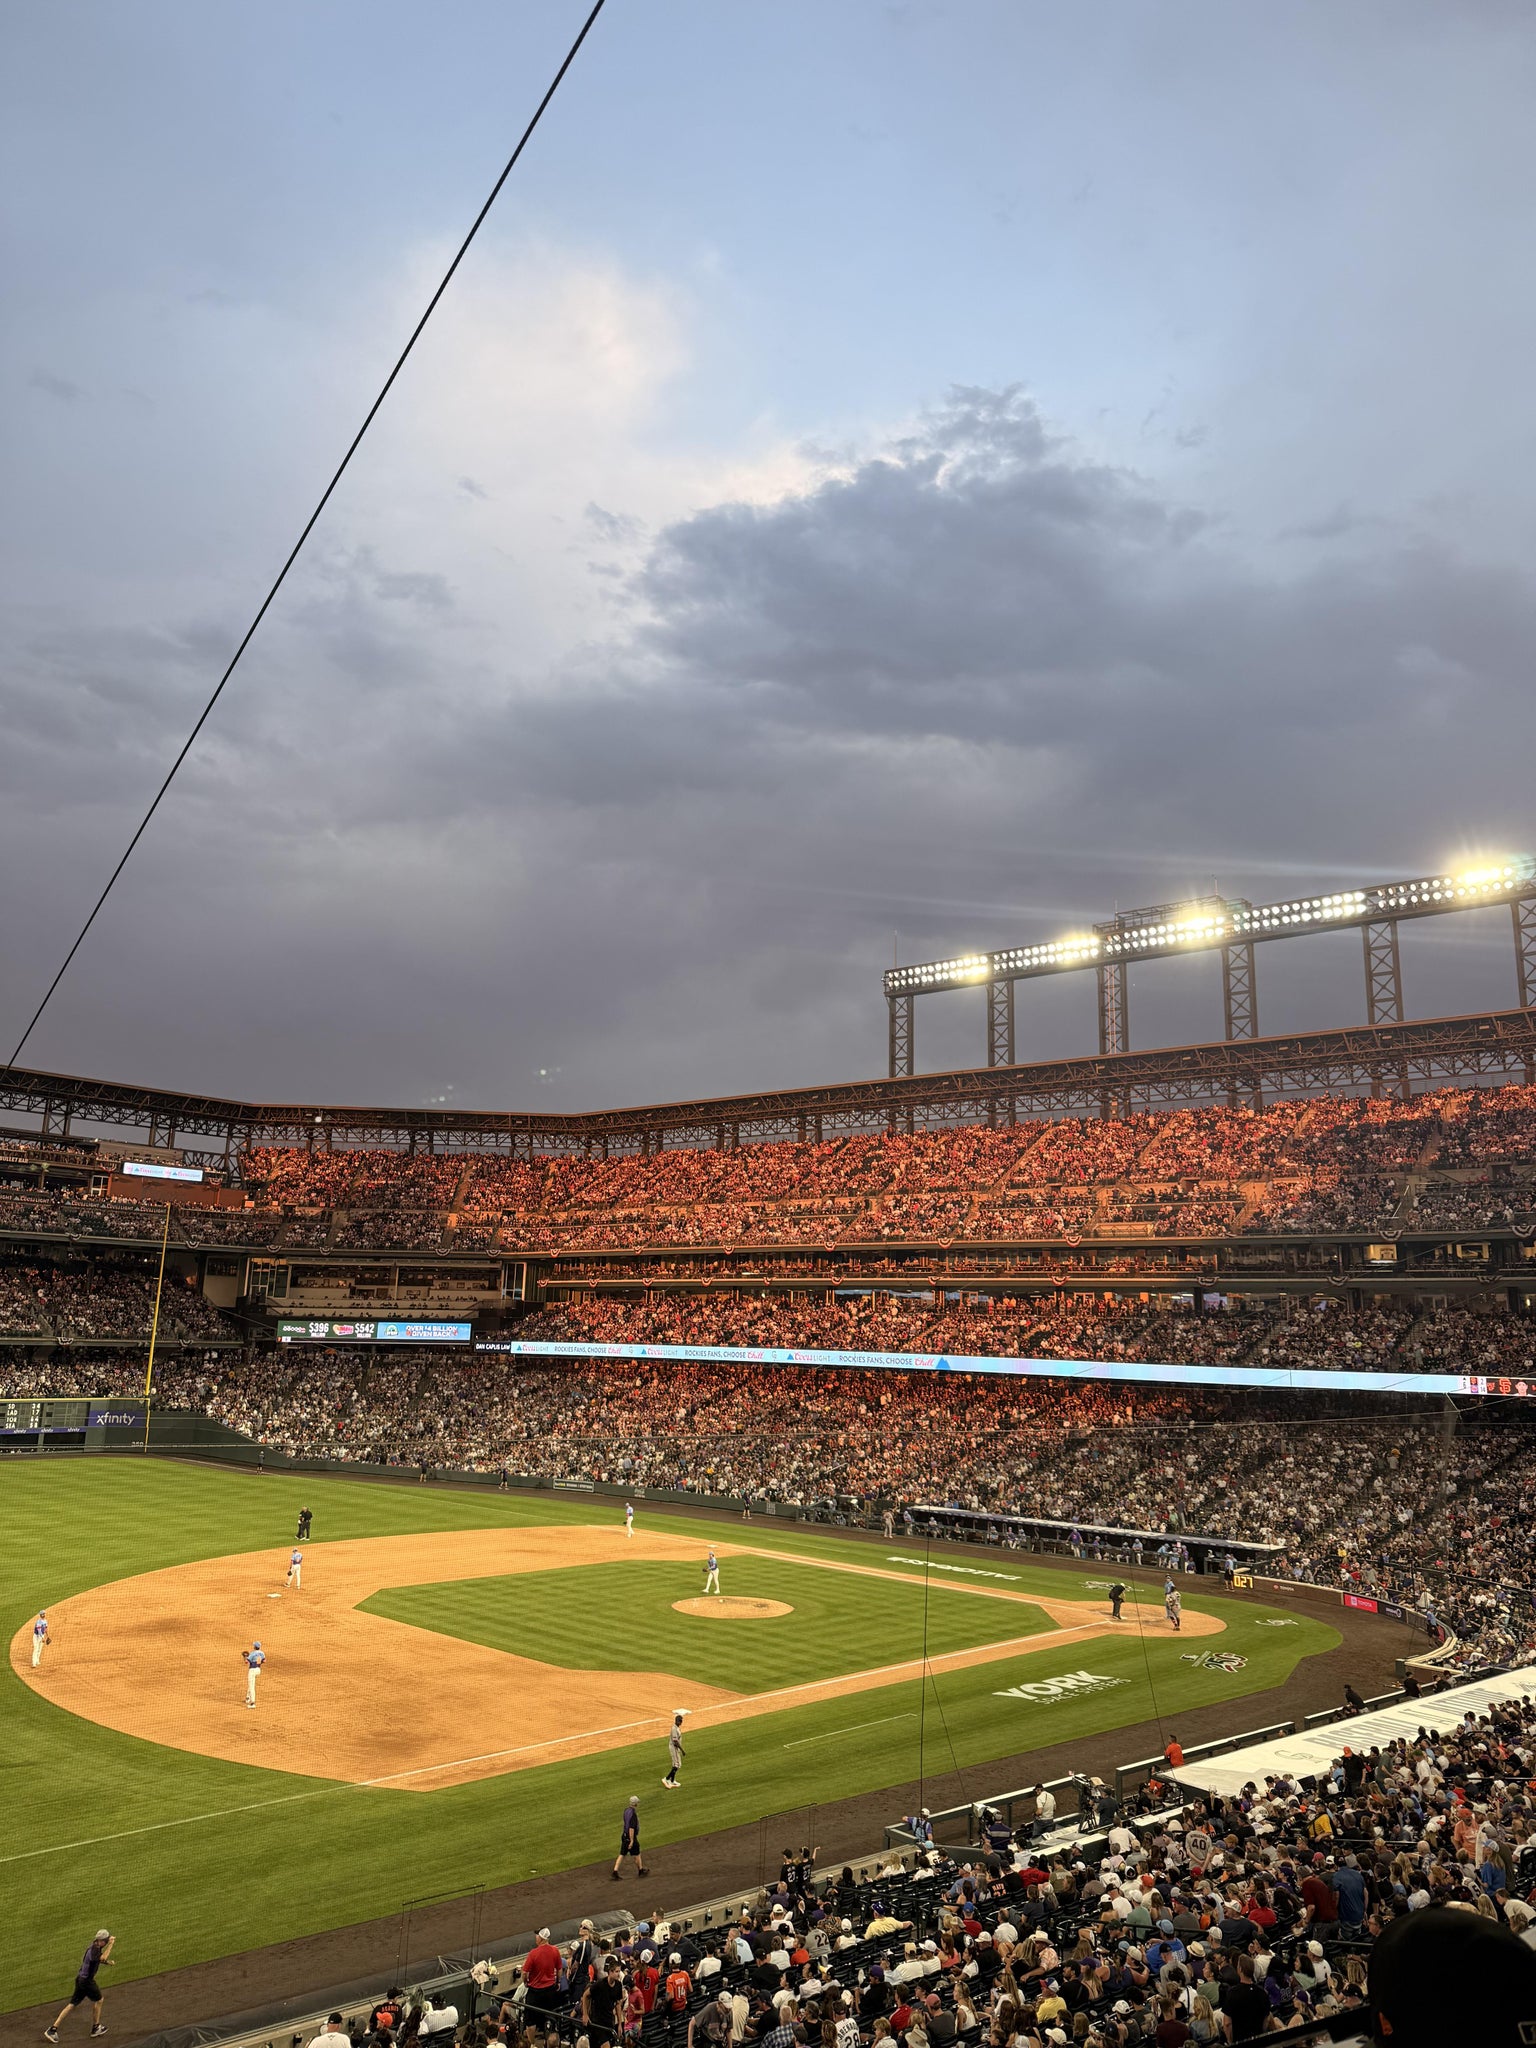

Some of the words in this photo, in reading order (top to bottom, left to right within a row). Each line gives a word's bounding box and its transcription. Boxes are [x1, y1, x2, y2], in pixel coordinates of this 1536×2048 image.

[309, 1322, 329, 1333] $396
[355, 1323, 375, 1334] $542
[684, 1349, 707, 1357] ROCKIES
[707, 1351, 723, 1359] FANS,
[723, 1351, 746, 1359] CHOOSE
[747, 1351, 764, 1360] Chill
[794, 1352, 813, 1361] Coors
[839, 1355, 866, 1363] ROCKIES
[867, 1356, 885, 1365] FANS,
[886, 1357, 912, 1366] CHOOSE
[914, 1358, 935, 1367] Chill
[96, 1411, 136, 1426] xfinity
[1233, 1575, 1254, 1589] 027
[1357, 1599, 1373, 1608] TOYOTA
[991, 1670, 1115, 1701] YORK
[1034, 1689, 1082, 1705] SPACE
[1074, 1677, 1132, 1694] SYSTEMS
[1191, 1838, 1207, 1851] 40
[815, 1931, 829, 1948] 22
[677, 1985, 686, 1998] 14
[844, 2032, 860, 2048] 28
